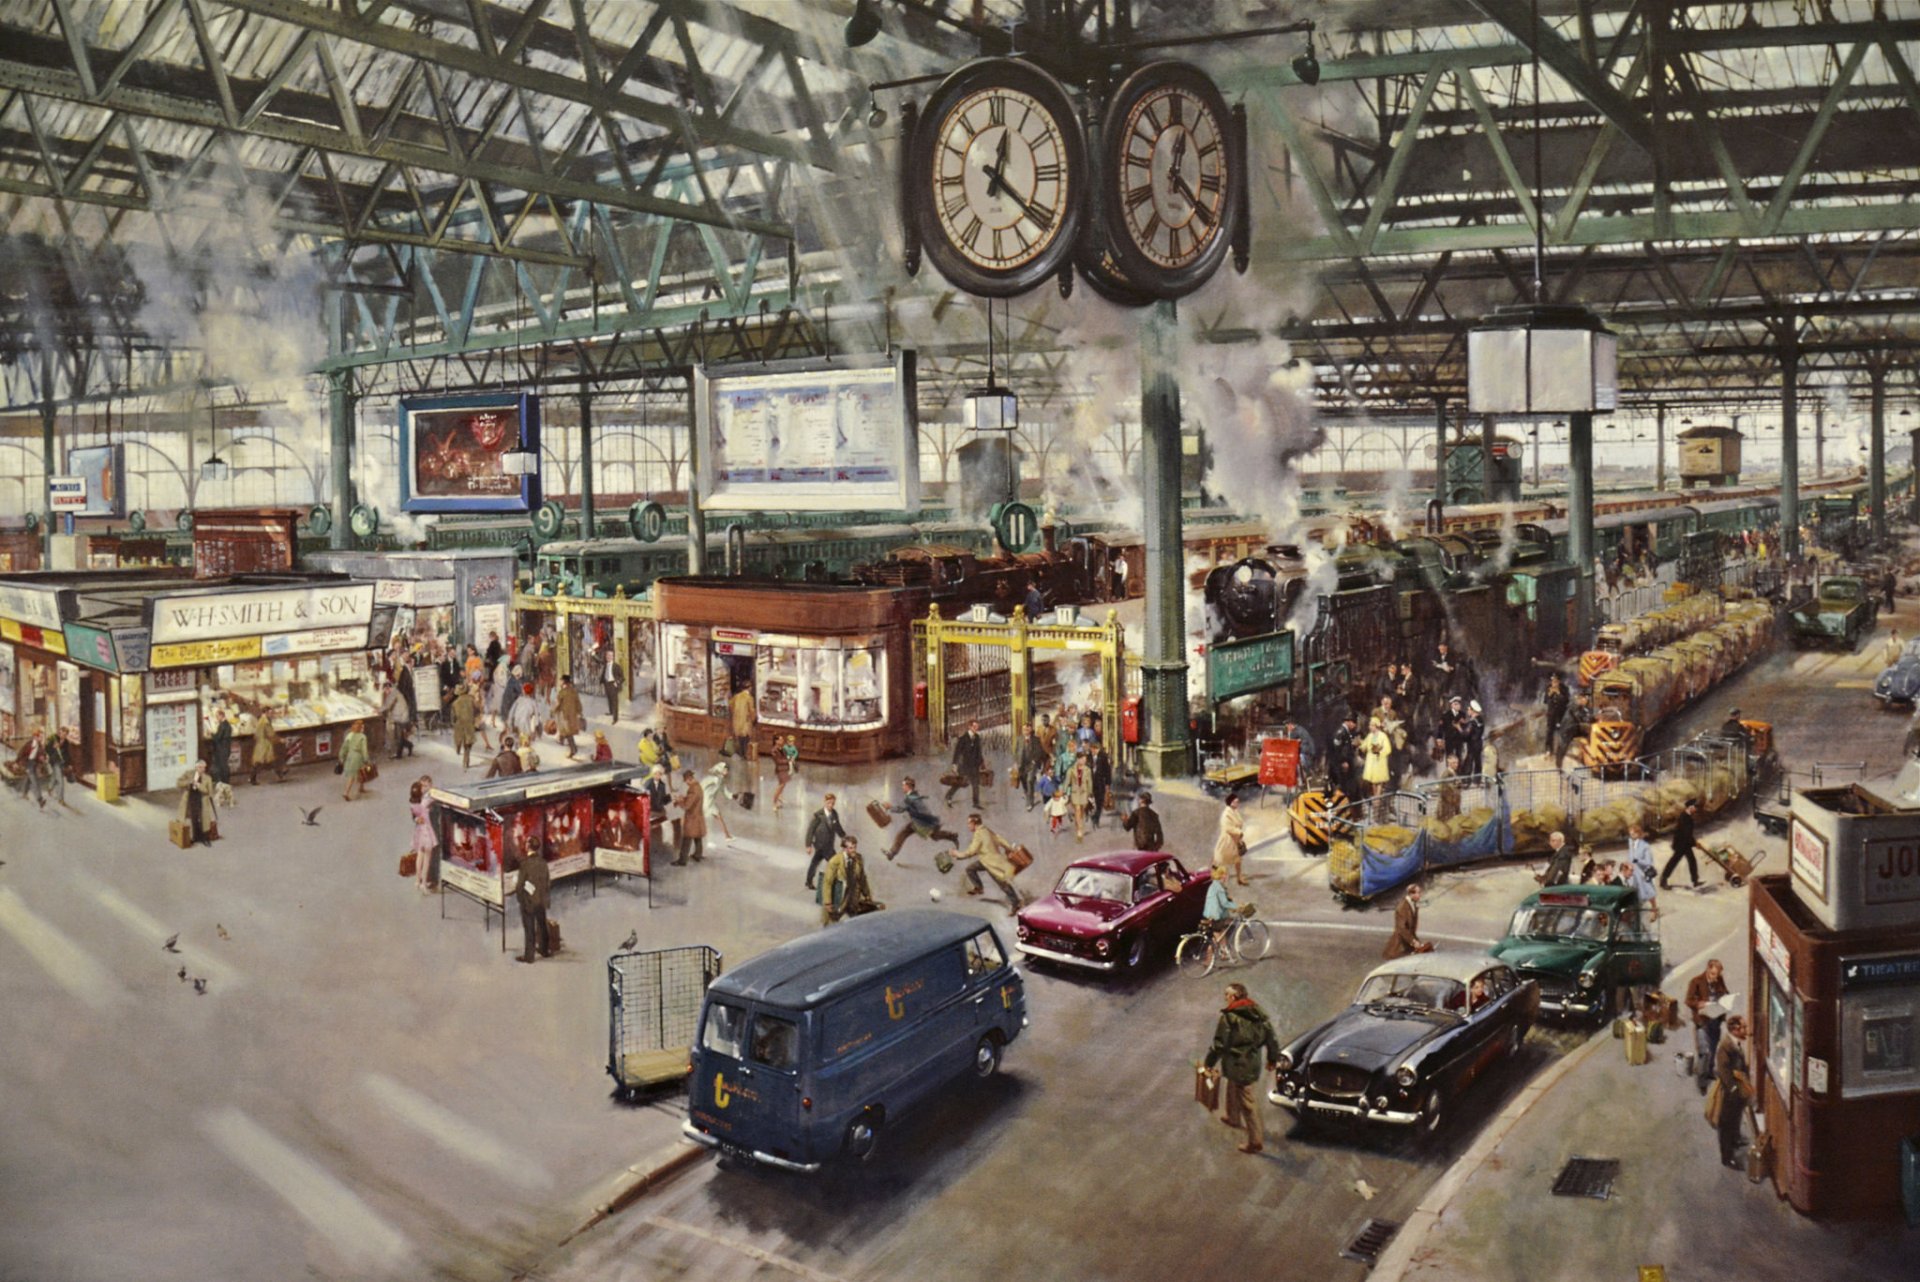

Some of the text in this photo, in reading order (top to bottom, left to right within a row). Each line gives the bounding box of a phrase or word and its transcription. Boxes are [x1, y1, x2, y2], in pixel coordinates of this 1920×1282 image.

[989, 97, 1006, 125] XII
[1036, 164, 1060, 181] III
[539, 506, 555, 532] 9
[644, 509, 660, 537] 10
[1009, 513, 1026, 546] 11
[294, 602, 308, 619] &
[317, 595, 358, 617] SON
[1877, 845, 1920, 879] JO
